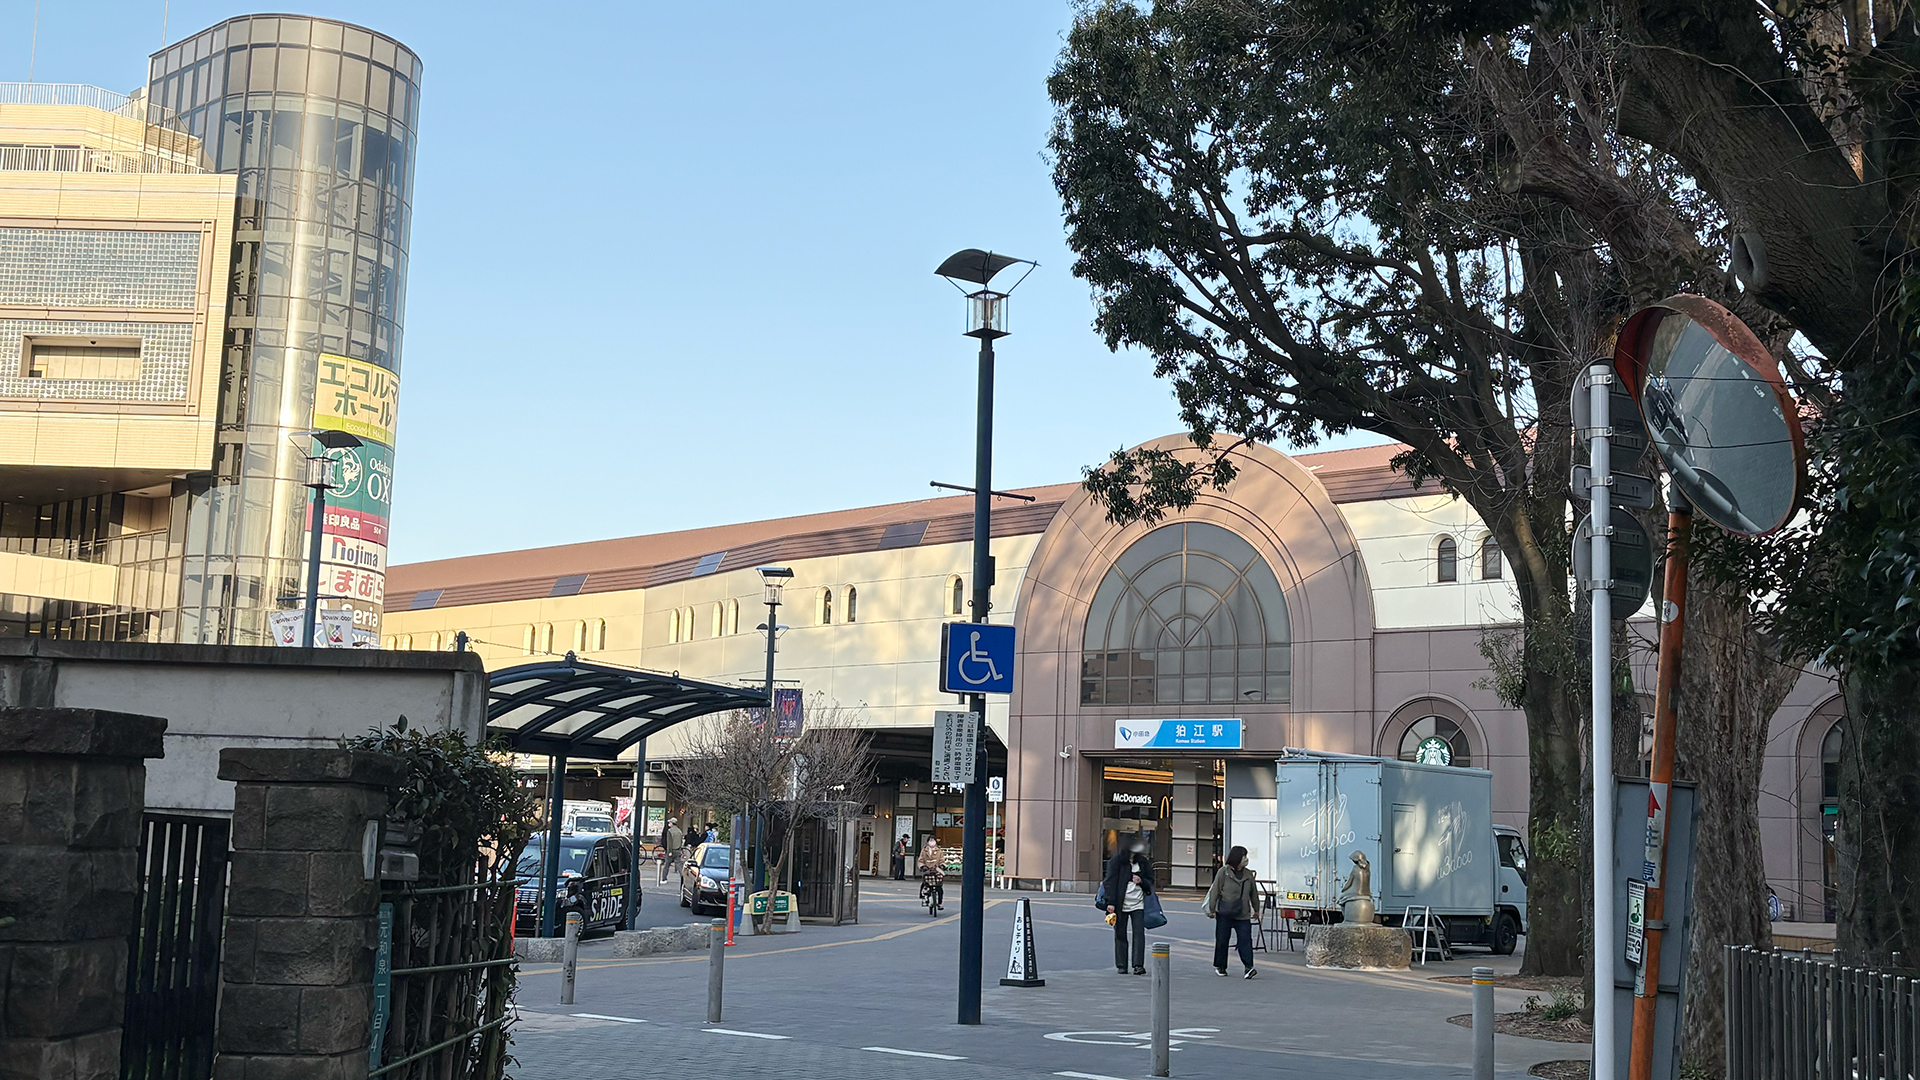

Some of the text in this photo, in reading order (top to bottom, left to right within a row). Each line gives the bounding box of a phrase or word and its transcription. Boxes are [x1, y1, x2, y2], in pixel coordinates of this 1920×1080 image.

[320, 361, 398, 404] エコルマ
[334, 389, 392, 426] ホール
[367, 473, 391, 504] OX
[1175, 724, 1223, 738] 狛江駅
[1112, 792, 1153, 805] McDonald's
[590, 895, 623, 922] S.RIDE
